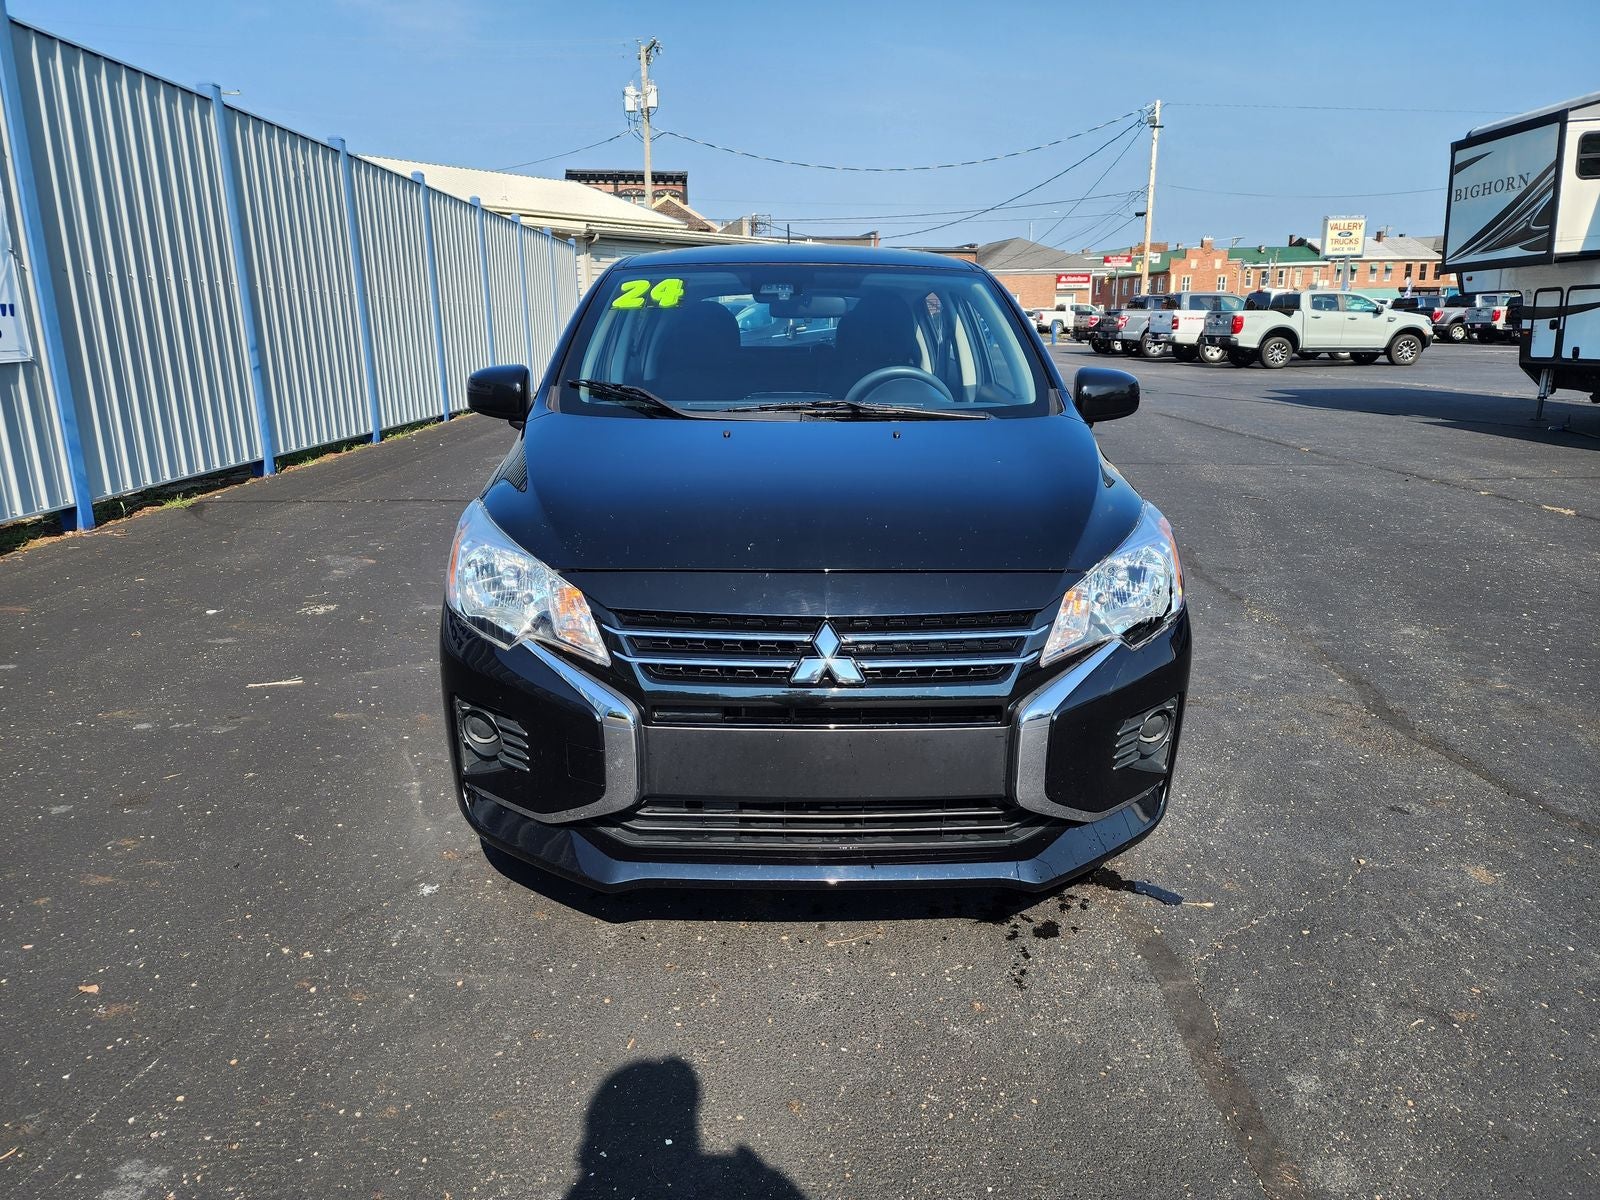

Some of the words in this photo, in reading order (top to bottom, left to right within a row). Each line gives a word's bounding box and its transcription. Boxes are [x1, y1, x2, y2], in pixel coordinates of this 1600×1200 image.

[1454, 172, 1530, 202] BIGHORN
[1329, 222, 1363, 231] VALLERY
[1330, 238, 1359, 246] TRUCKS
[611, 278, 684, 308] 24
